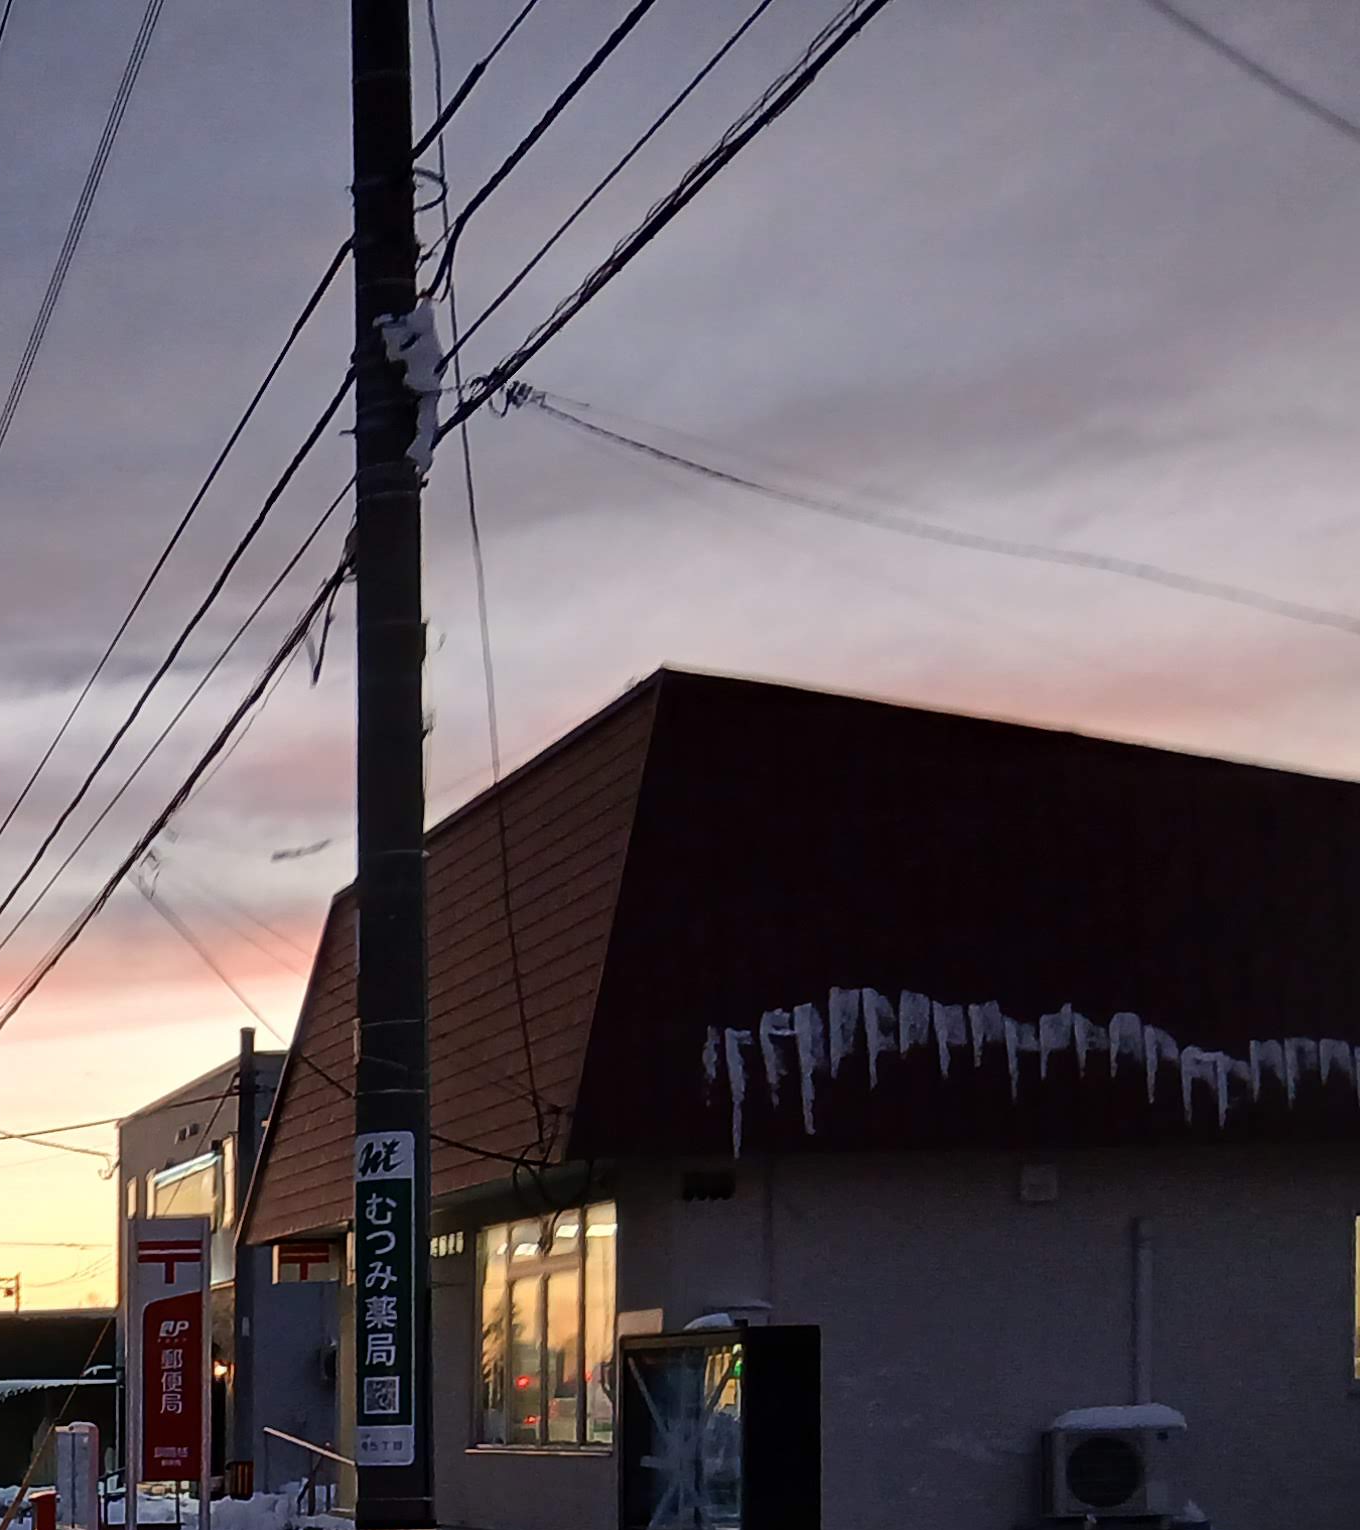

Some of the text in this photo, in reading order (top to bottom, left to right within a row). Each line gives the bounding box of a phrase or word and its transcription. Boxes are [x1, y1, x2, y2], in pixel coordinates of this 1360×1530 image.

[365, 1193, 398, 1366] むつみ薬局
[160, 1348, 183, 1414] 郵便局
